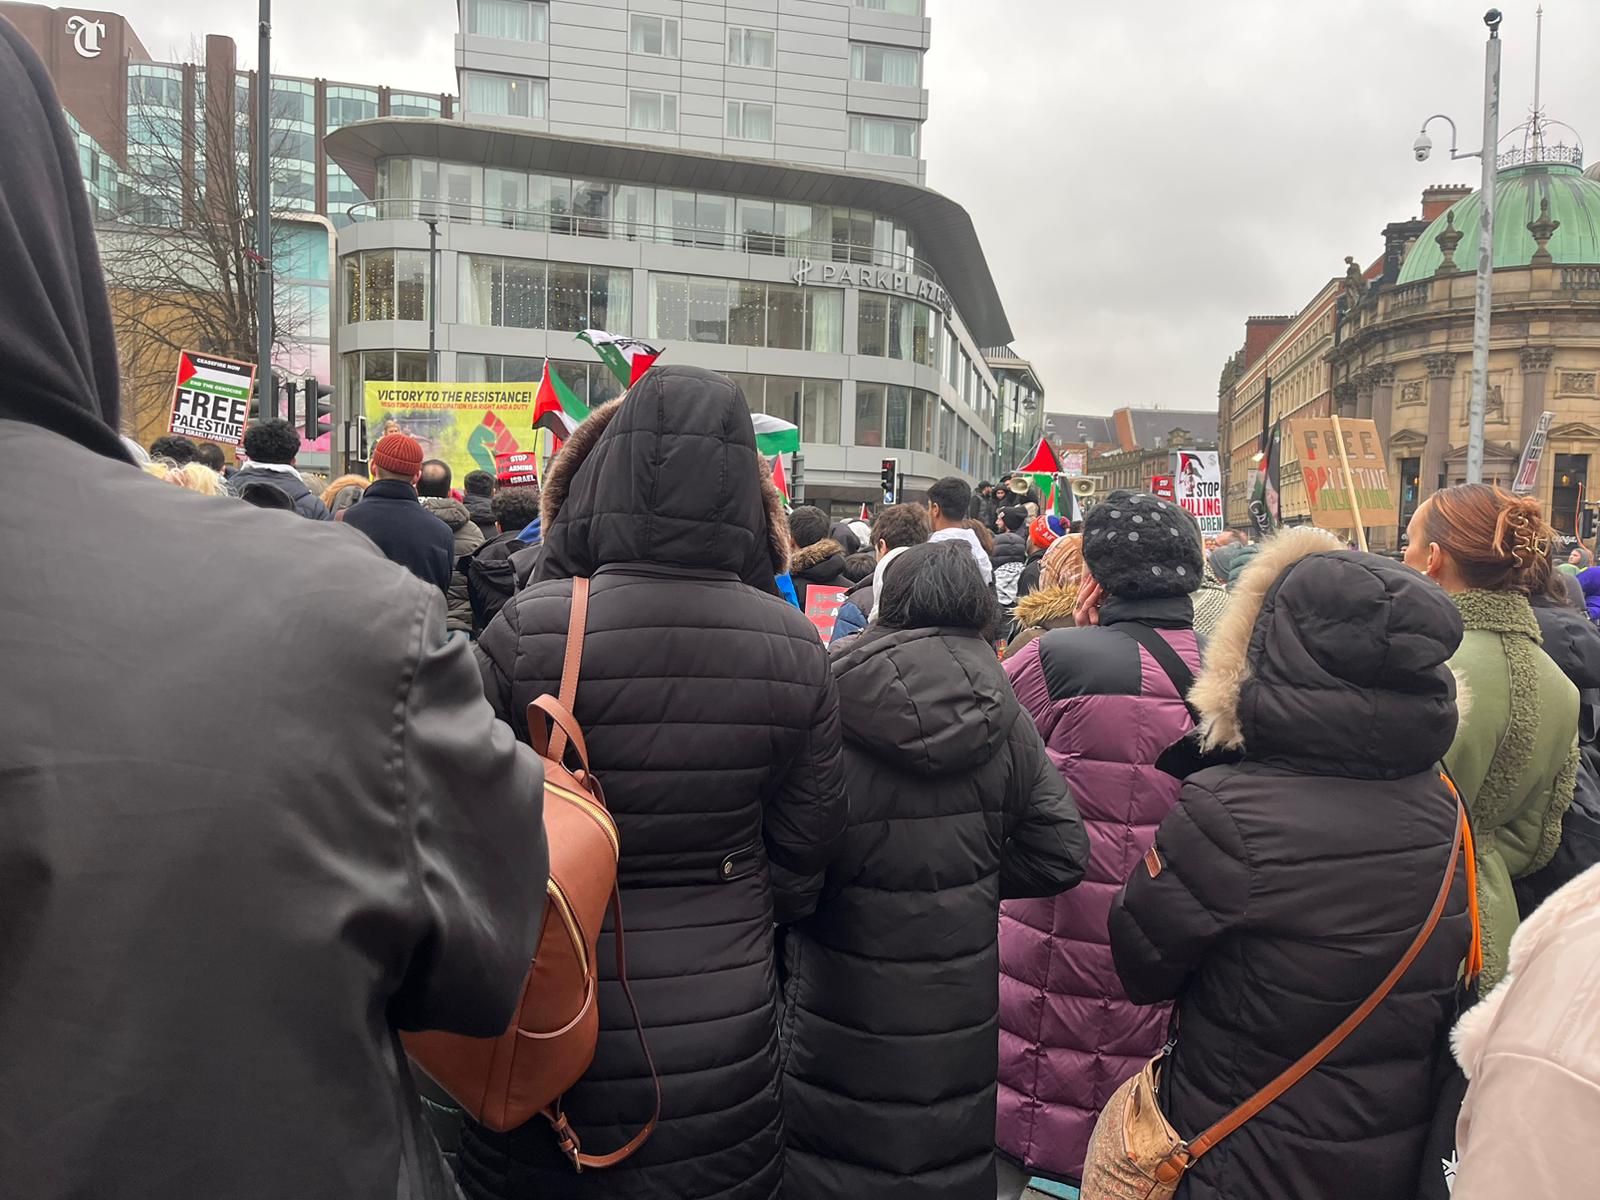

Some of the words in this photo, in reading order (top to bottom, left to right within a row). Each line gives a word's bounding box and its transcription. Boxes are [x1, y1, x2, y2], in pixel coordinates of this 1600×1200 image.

[196, 358, 226, 369] CEASEFIRE
[227, 364, 241, 372] NOW
[202, 382, 214, 390] THE
[214, 384, 243, 395] GENOCIDE
[377, 390, 424, 402] VICTORY
[425, 390, 439, 402] TO
[441, 391, 463, 402] THE
[464, 391, 532, 403] RESISTANCE!
[174, 389, 247, 425] FREE
[173, 413, 243, 438] PALESTINE
[1303, 430, 1377, 460] FREE
[510, 454, 528, 462] STOP
[509, 464, 534, 472] ARMING
[510, 474, 535, 484] ISRAEL
[1196, 482, 1220, 497] STOP
